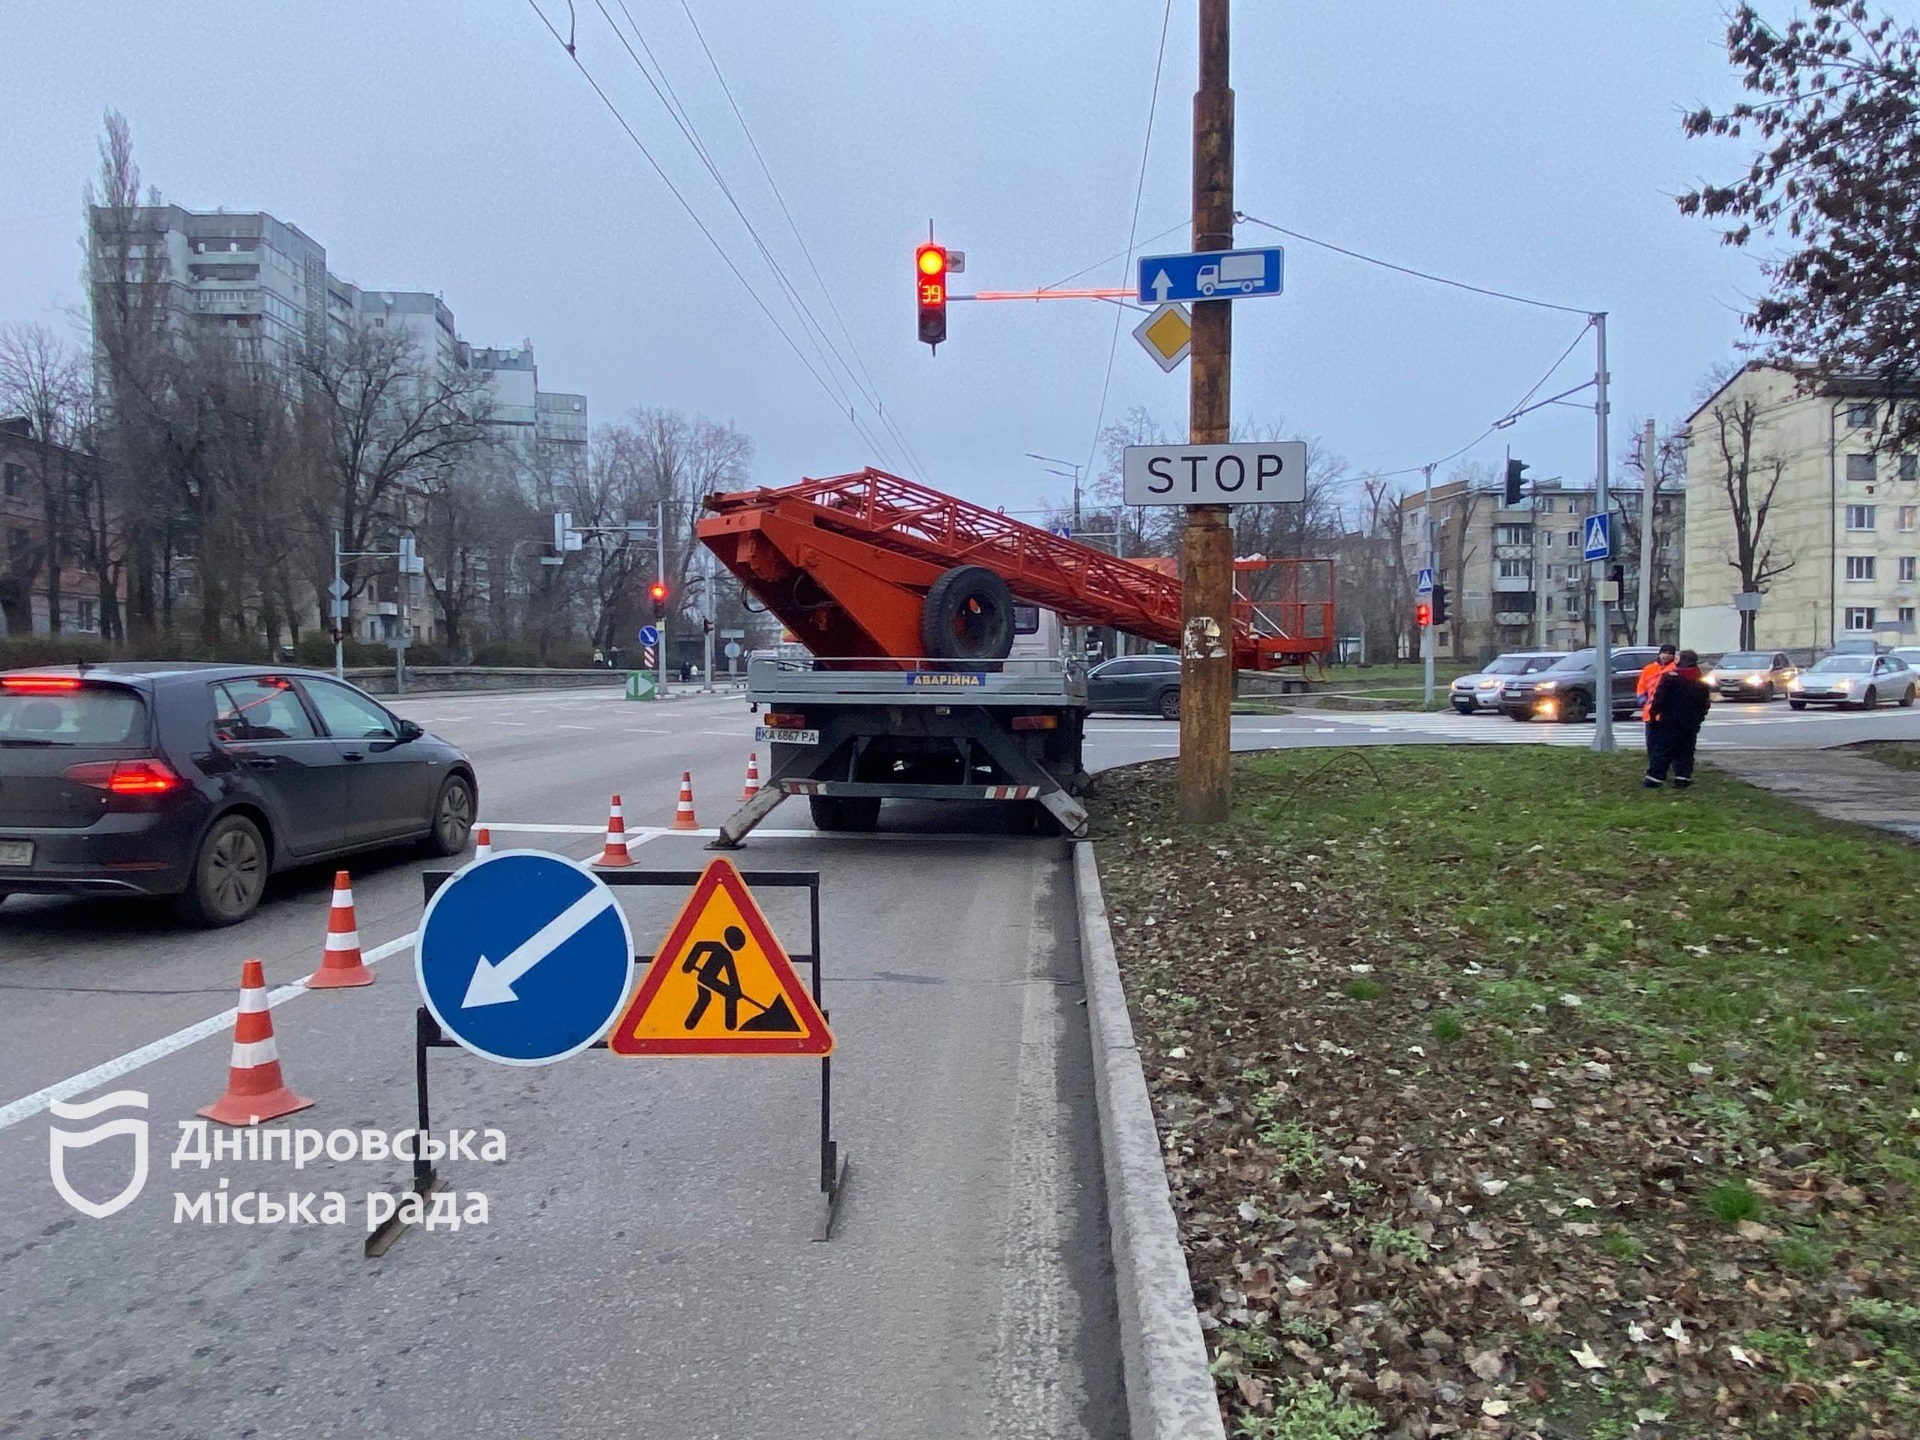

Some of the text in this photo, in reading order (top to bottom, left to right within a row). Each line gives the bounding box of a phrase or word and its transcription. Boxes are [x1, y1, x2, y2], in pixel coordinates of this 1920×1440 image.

[922, 285, 941, 303] 39
[1147, 455, 1283, 493] STOP
[914, 674, 979, 685] АВАРІЙНА
[761, 729, 776, 740] KA
